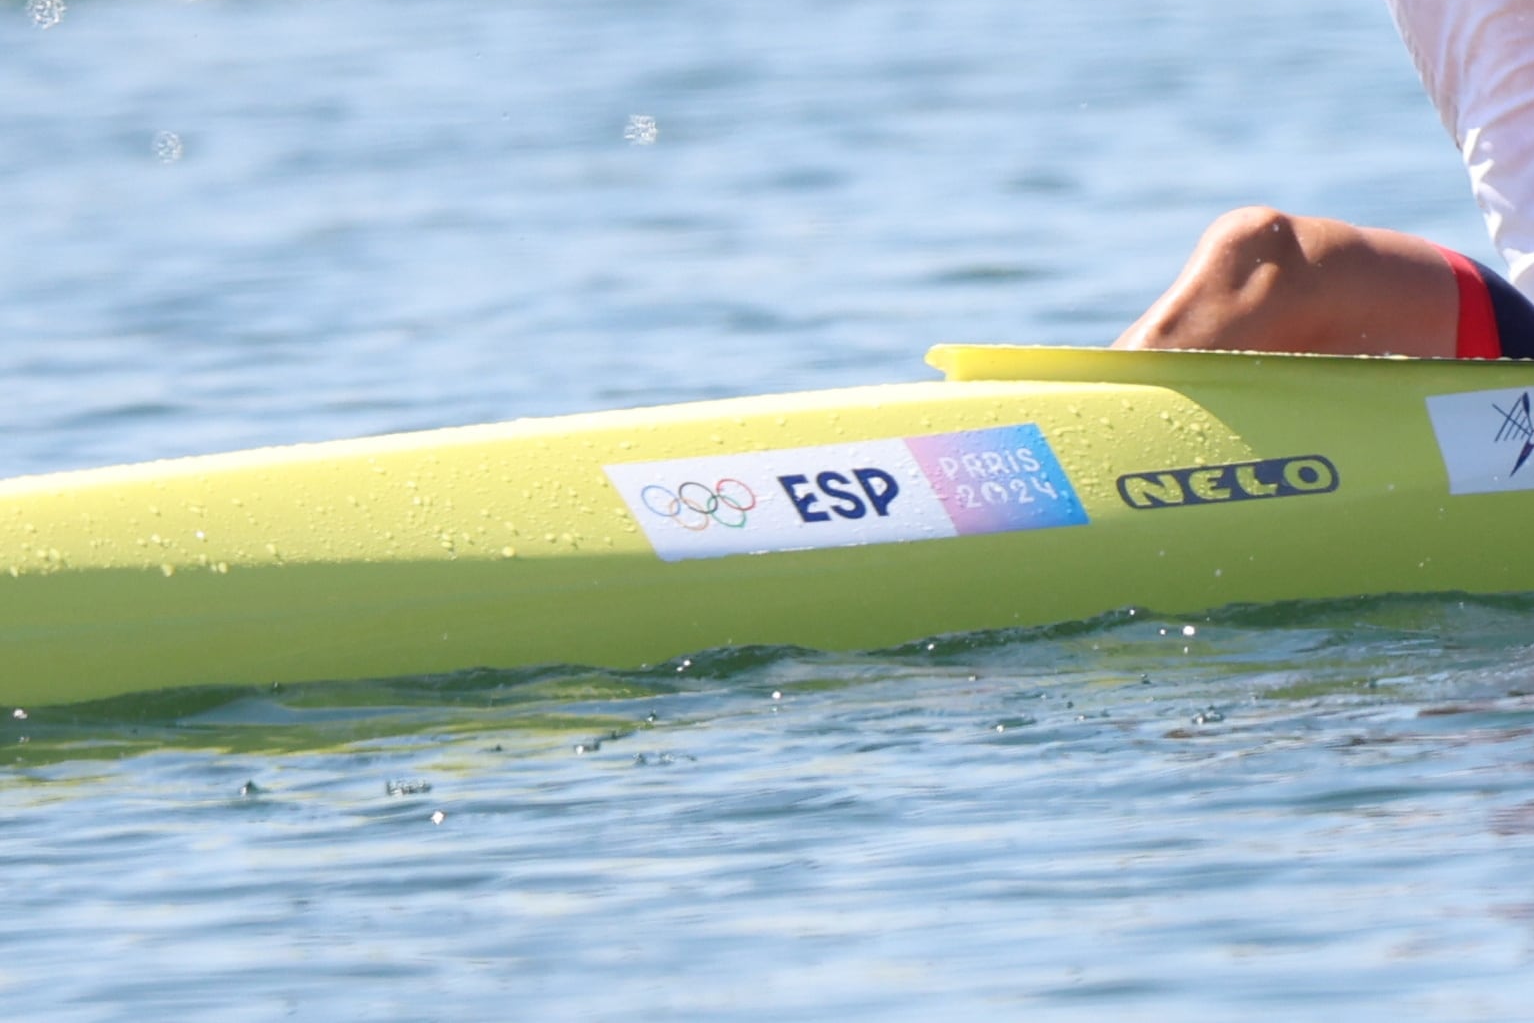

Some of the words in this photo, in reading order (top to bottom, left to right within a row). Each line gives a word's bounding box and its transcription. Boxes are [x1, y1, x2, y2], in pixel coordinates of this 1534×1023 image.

[939, 447, 1040, 480] PARIS
[1125, 459, 1333, 507] NELO
[777, 468, 900, 523] ESP
[956, 476, 1058, 508] 2024
